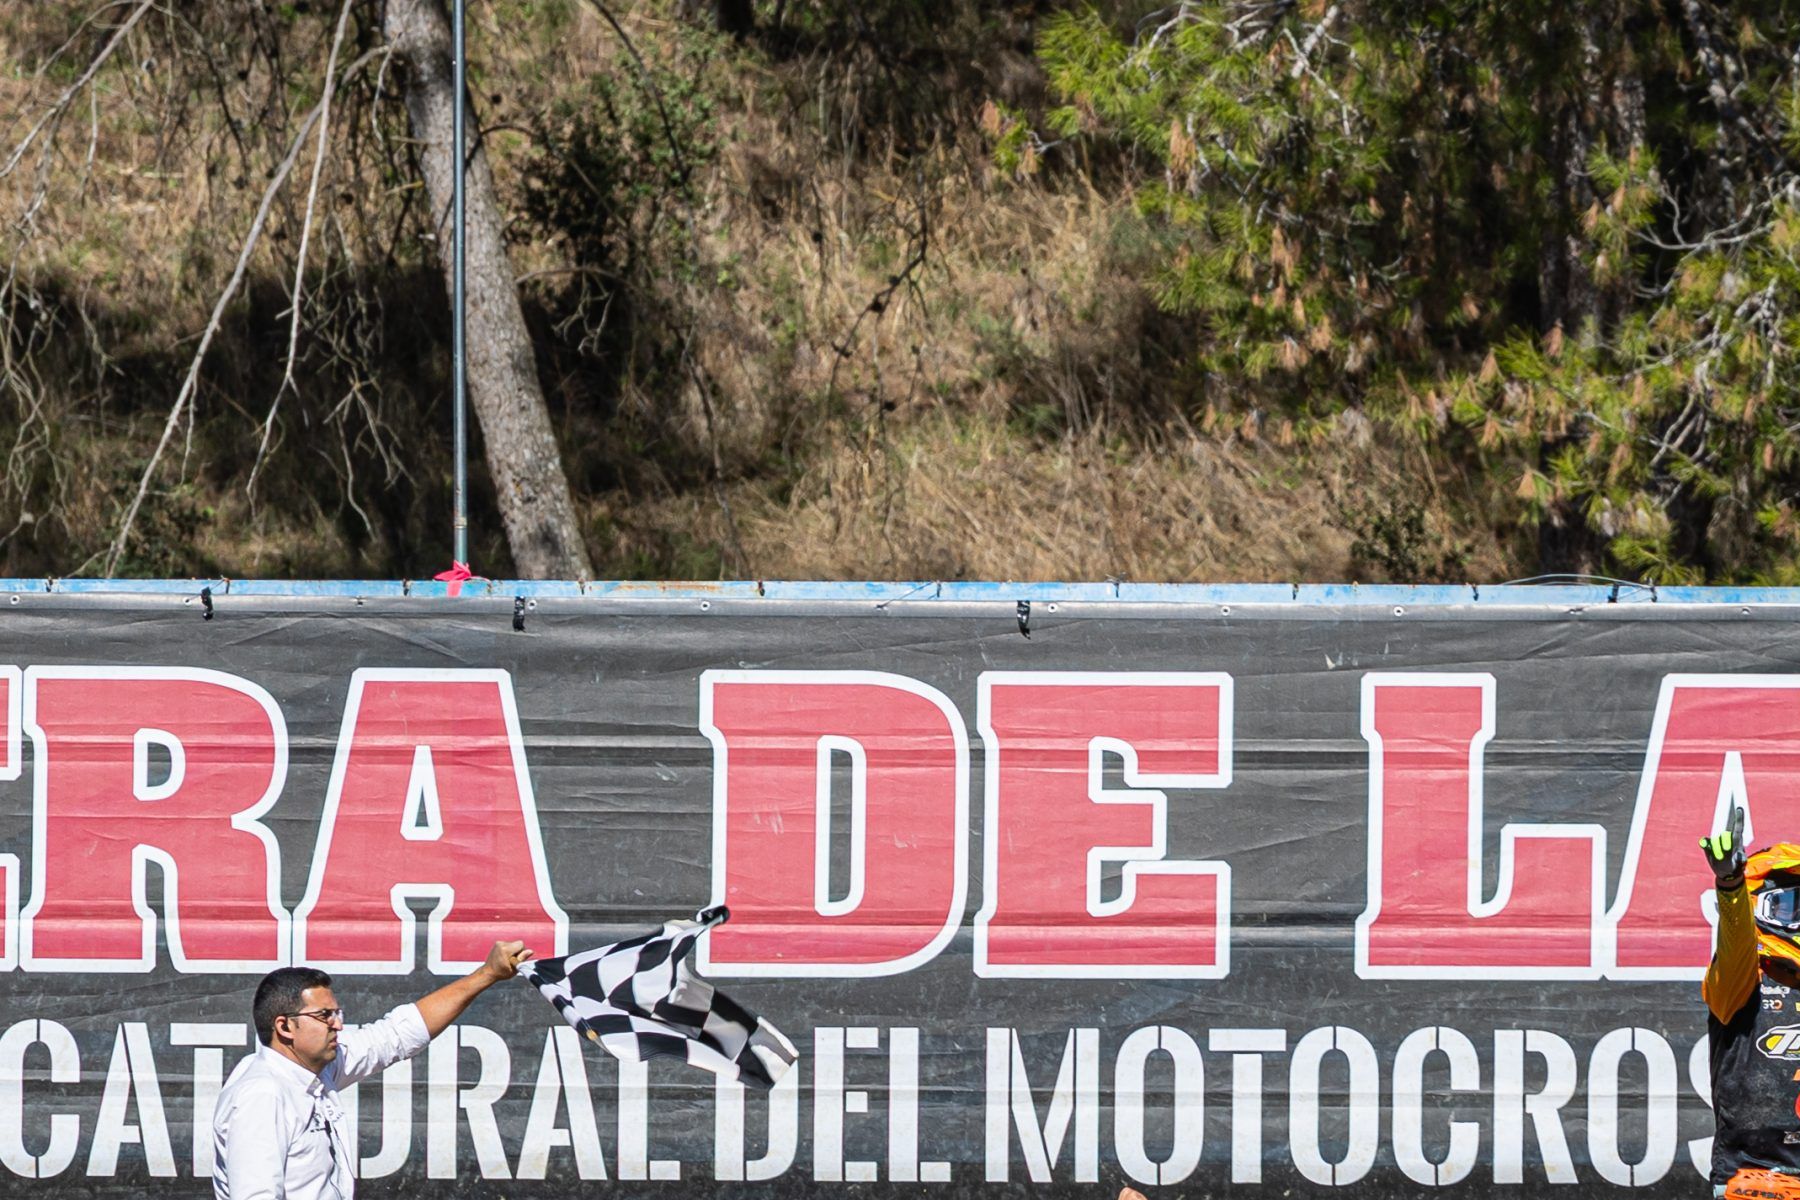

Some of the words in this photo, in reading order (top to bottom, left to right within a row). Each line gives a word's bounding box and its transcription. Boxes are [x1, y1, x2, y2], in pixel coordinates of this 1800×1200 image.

[0, 664, 569, 975] RA
[695, 669, 1234, 979] DE
[0, 1018, 681, 1182] CATDRAL
[716, 1026, 952, 1183] DEL
